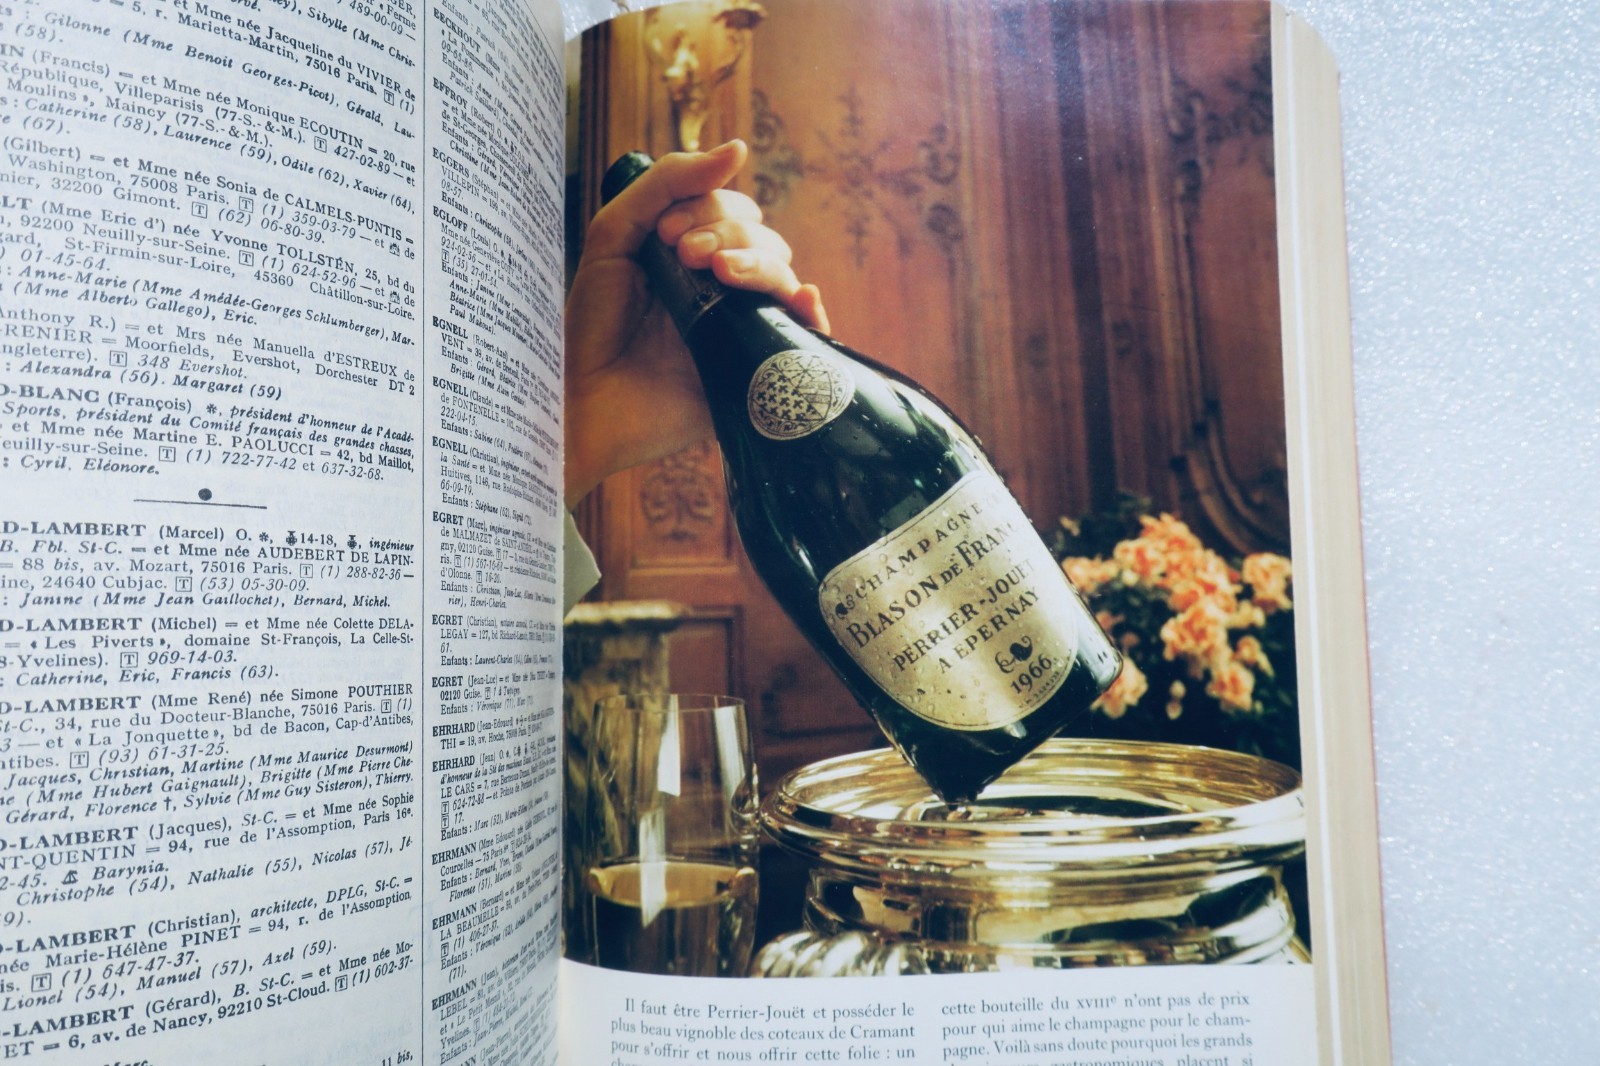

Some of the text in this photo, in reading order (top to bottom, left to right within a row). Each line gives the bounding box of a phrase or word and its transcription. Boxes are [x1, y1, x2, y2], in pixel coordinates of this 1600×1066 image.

[434, 7, 480, 52] EECKHOUT
[196, 2, 415, 102] Mme née Jacqueline du VIVIER de
[45, 12, 110, 36] Gilonne
[124, 30, 173, 51] (Mme
[185, 46, 232, 68] Benoit
[242, 63, 334, 102] Georges-Picot),
[347, 101, 383, 126] Gérald,
[433, 77, 468, 108] EFFROY
[25, 98, 411, 211] Catherine (58), Laurence (59), Odile (62), Xavier (64),
[433, 147, 469, 178] EGGERS
[433, 206, 468, 232] EGLOFF
[42, 202, 414, 294] (Mme Eric d') née Yvonne TOLLSTÉN, 25, bd du
[442, 261, 468, 282] Enfants
[432, 315, 468, 339] EGNELL
[433, 376, 468, 397] EGNELL
[2, 403, 414, 459] Sports, président du Comité français des grandes chasses,
[432, 436, 468, 455] EGNELL
[84, 460, 159, 474] Eléonore.
[442, 493, 468, 507] Enfants
[433, 511, 464, 526] EGRET
[159, 526, 224, 540] (Marcel)
[369, 538, 414, 551] ingénieur
[22, 559, 400, 580] 88 bis, av. Mozart, 75016 Paris. (1) 288-82-36
[847, 576, 946, 649] BLASON
[943, 561, 964, 585] DE
[432, 614, 463, 625] EGRET
[939, 587, 1040, 673] A EPERNAY
[440, 628, 468, 639] LEGAY
[441, 655, 468, 666] Enfants
[432, 676, 463, 688] EGRET
[1010, 653, 1052, 695] 1966
[55, 698, 412, 730] 34, rue du Docteur-Blanche, 75016 Paris. (1)
[432, 722, 475, 737] EHRHARD
[432, 755, 475, 772] EHRHARD
[432, 842, 476, 865] EHRMANN
[16, 842, 392, 905] Christophe (54), Nathalie (55), Nicolas (57),
[440, 875, 467, 891] Enfants
[251, 897, 317, 918] architecte,
[326, 885, 367, 903] DPLG,
[432, 902, 476, 930] EHRMANN
[46, 891, 411, 968] Marie-Hélène PINET 94, r. de l'Assomption
[432, 978, 476, 1011] EHRMANN
[942, 1004, 975, 1014] cette
[982, 997, 1043, 1012] bouteille
[1051, 996, 1068, 1009] du
[1125, 994, 1160, 1007] n'ont
[1168, 997, 1190, 1010] pas
[1198, 992, 1214, 1005] de
[1220, 996, 1249, 1009] prix
[92, 982, 330, 1044] av. de Nancy, 92210 St-Cloud.
[626, 998, 914, 1022] Il faut être Perrier-Jouët et posséder le
[611, 1020, 913, 1040] plus beau vignoble des coteaux de Cramant
[943, 1012, 1250, 1040] pour qui aime le champagne pour le cham-
[611, 1041, 914, 1060] pour s'offrir et nous offrir cette folie un
[943, 1033, 1252, 1061] pagne. Voilà sans doute pourquoi les grands
